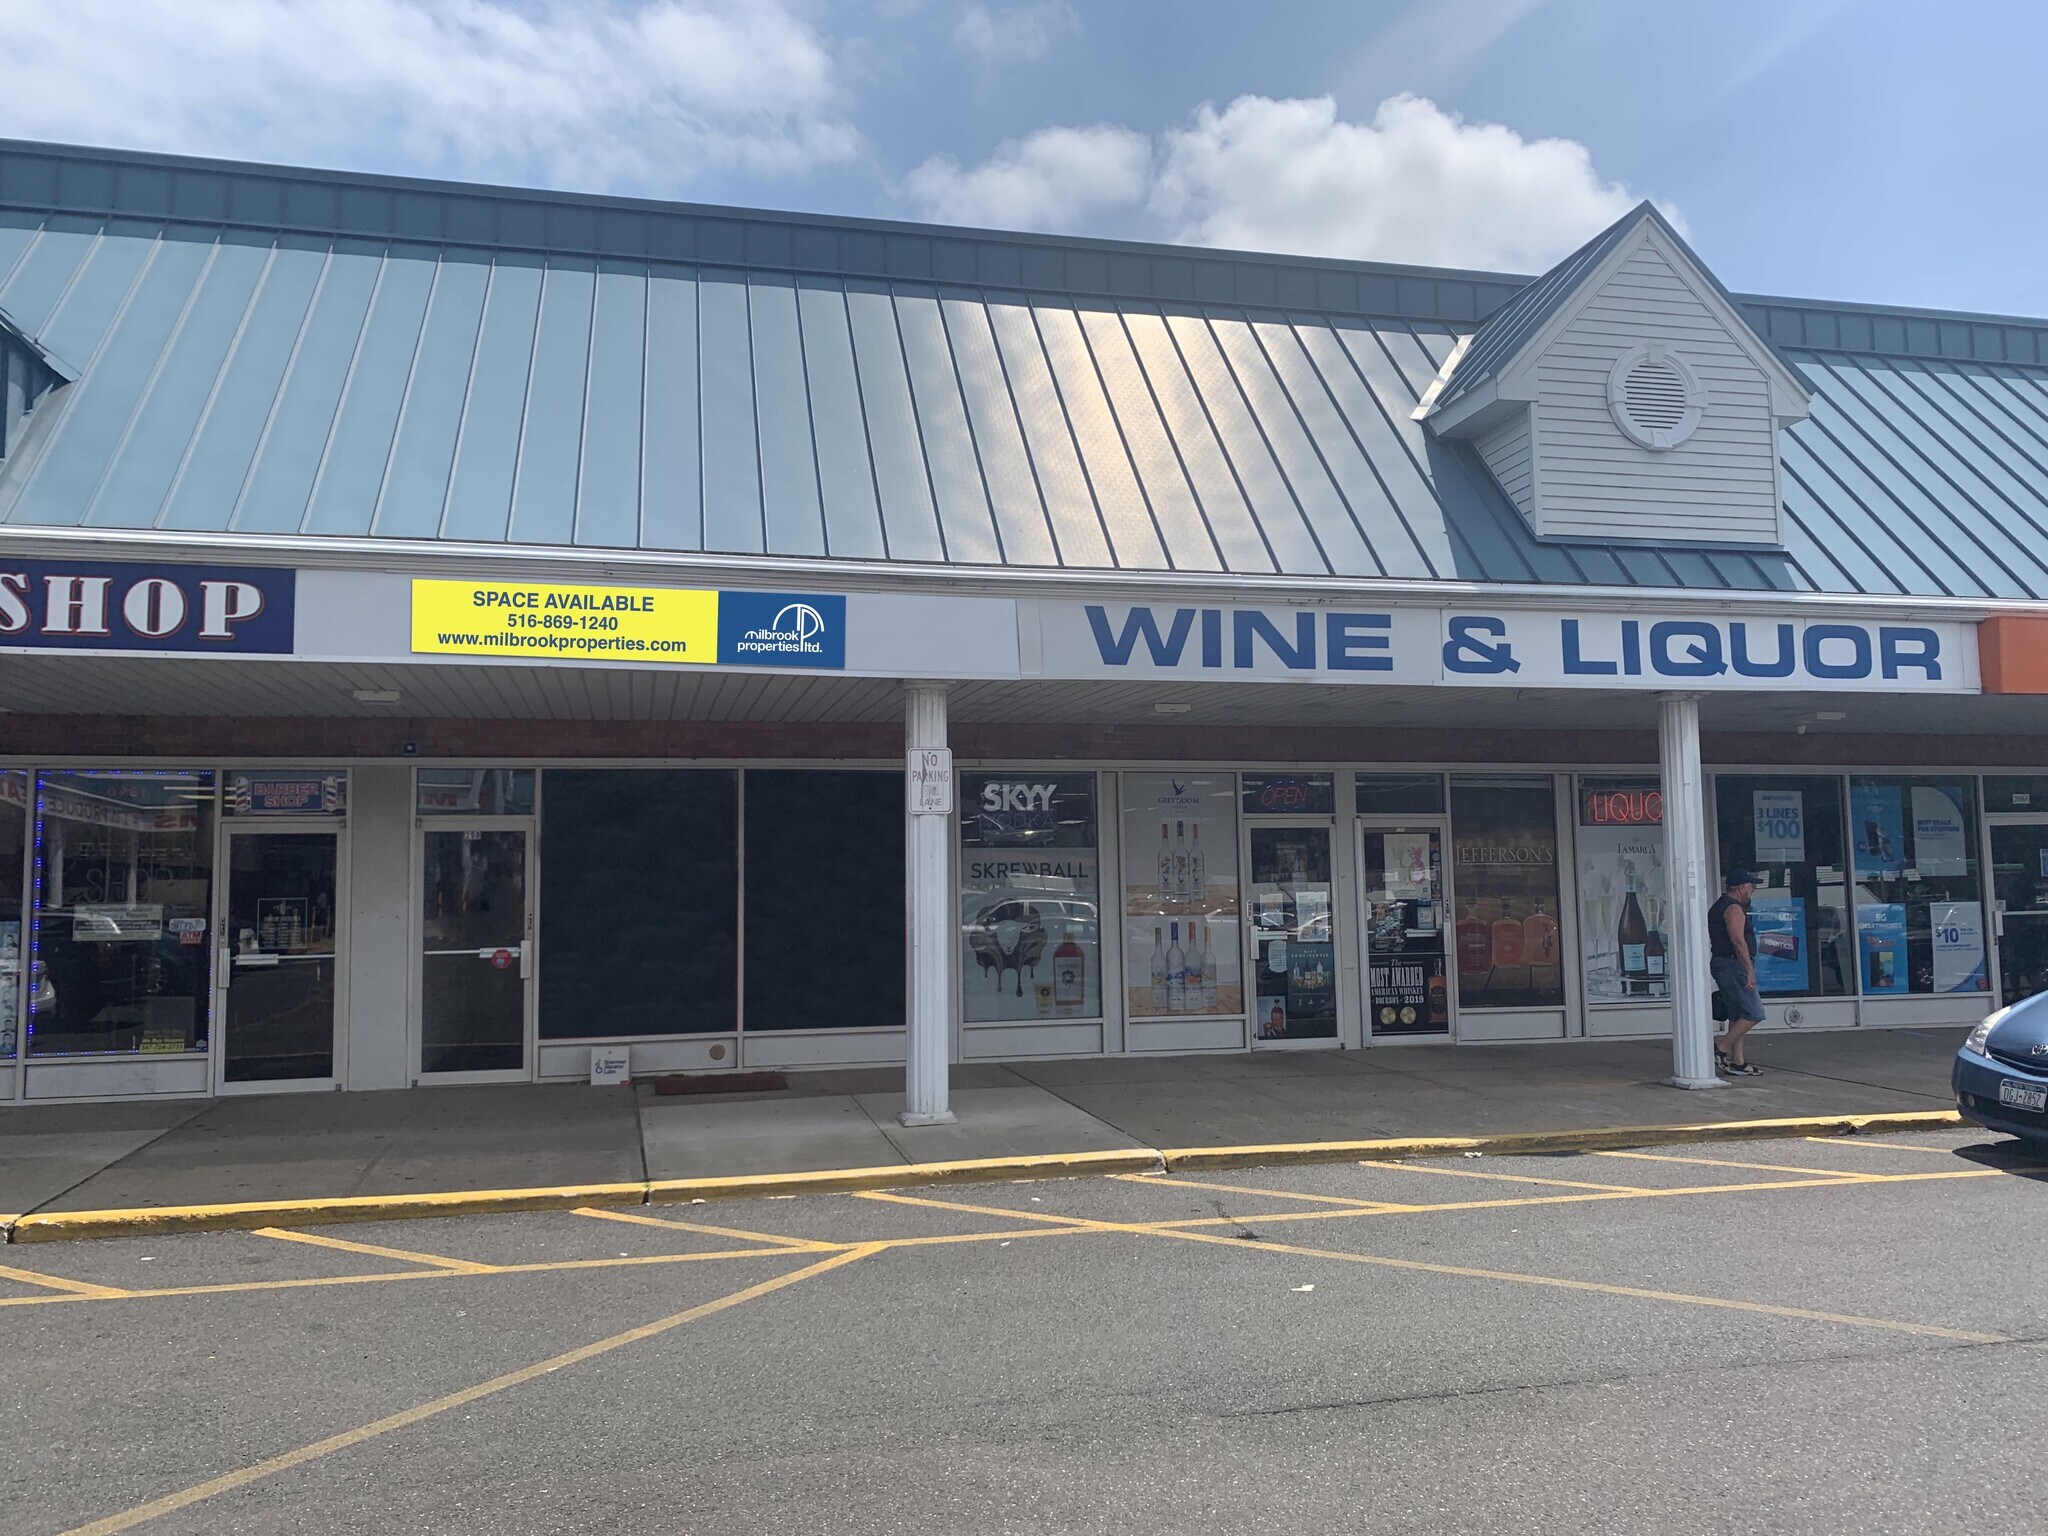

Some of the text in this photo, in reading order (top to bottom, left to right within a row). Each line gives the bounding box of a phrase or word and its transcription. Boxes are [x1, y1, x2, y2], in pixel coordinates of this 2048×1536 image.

[0, 573, 264, 639] SHOP
[473, 591, 655, 612] SPACE AVAILABLE
[507, 614, 618, 630] 516-869-1240
[437, 632, 687, 652] www.milbrookproperties.com
[744, 629, 799, 641] milbrook
[1084, 605, 1942, 680] WINE & LIQUOR
[737, 641, 799, 653] properties
[922, 754, 938, 766] NO
[254, 783, 319, 795] BARBER
[1261, 785, 1308, 806] OPEN
[264, 795, 308, 807] SHOP
[920, 798, 942, 806] LANE
[983, 784, 1058, 811] SKYY
[984, 813, 1056, 829] VODKA
[1757, 808, 1798, 819] 3 LINES
[1758, 819, 1800, 839] $100
[1456, 845, 1553, 866] JEFFERSON'S
[970, 862, 1089, 878] SKREWBALL
[1875, 913, 1887, 922] 5G
[181, 931, 202, 939] ATM
[1934, 927, 1960, 943] $10
[1390, 958, 1402, 966] The
[1370, 966, 1424, 987] MOST AWARDED
[1371, 987, 1398, 996] AMERICAN
[1399, 987, 1423, 995] WHISKEY
[1375, 996, 1399, 1005] BOURBON
[1403, 995, 1424, 1004] 2019
